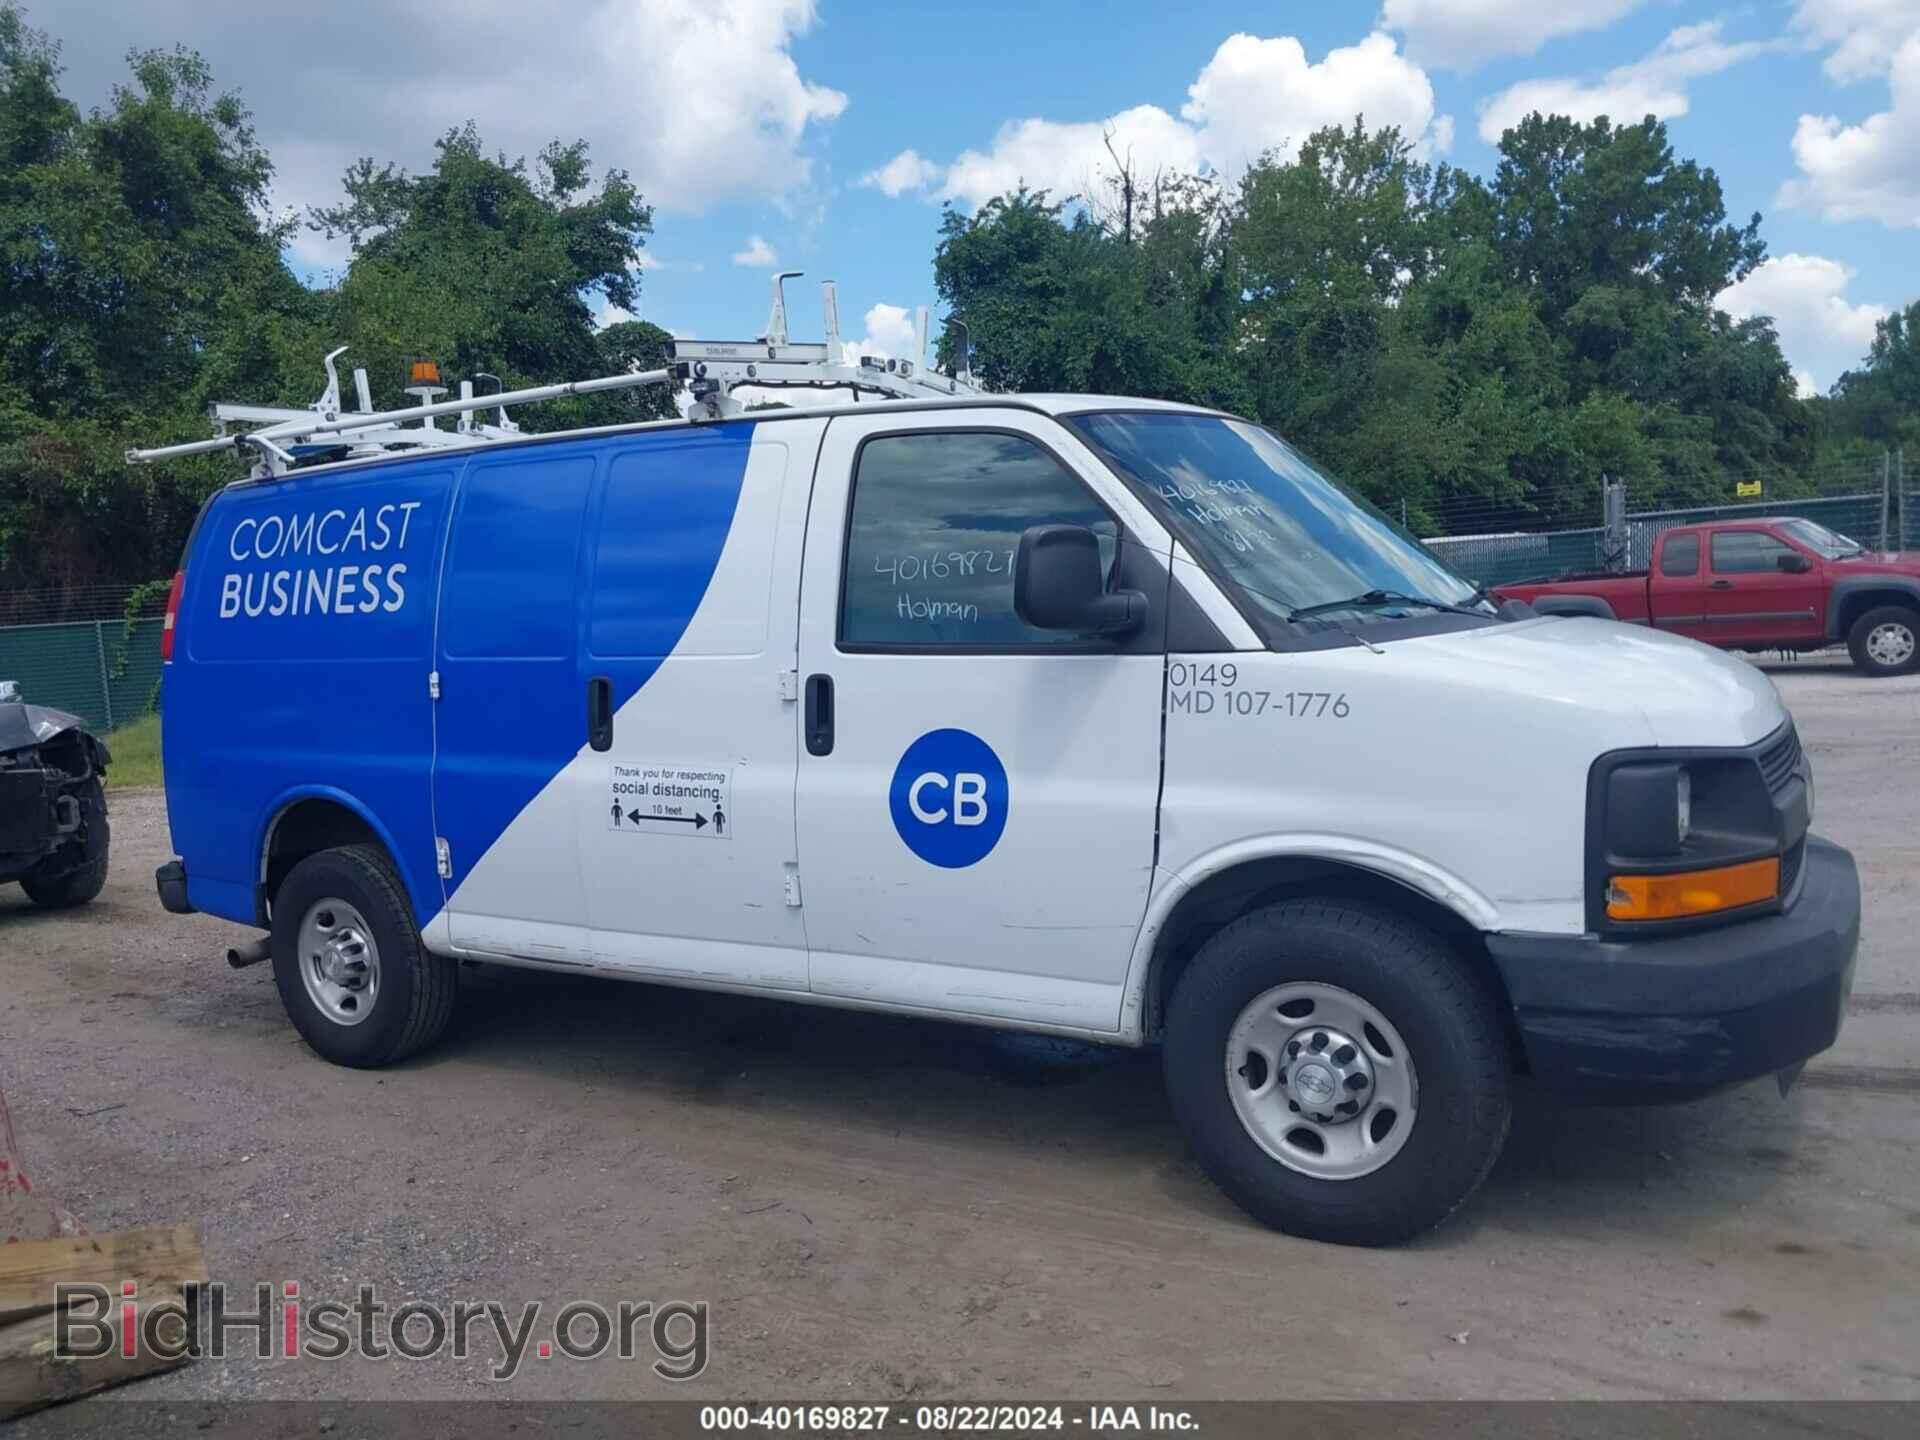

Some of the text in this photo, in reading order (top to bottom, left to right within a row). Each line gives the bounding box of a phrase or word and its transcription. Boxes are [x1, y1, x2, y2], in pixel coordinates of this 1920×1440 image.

[229, 502, 422, 561] COMCAST
[219, 562, 408, 619] BUSINESS
[1169, 663, 1238, 688] 0149
[1170, 690, 1351, 719] MD 107-1776
[613, 765, 726, 784] Thank you for respecting
[612, 781, 724, 803] social distancing.
[908, 771, 988, 826] CB
[652, 804, 683, 816] 10 feet
